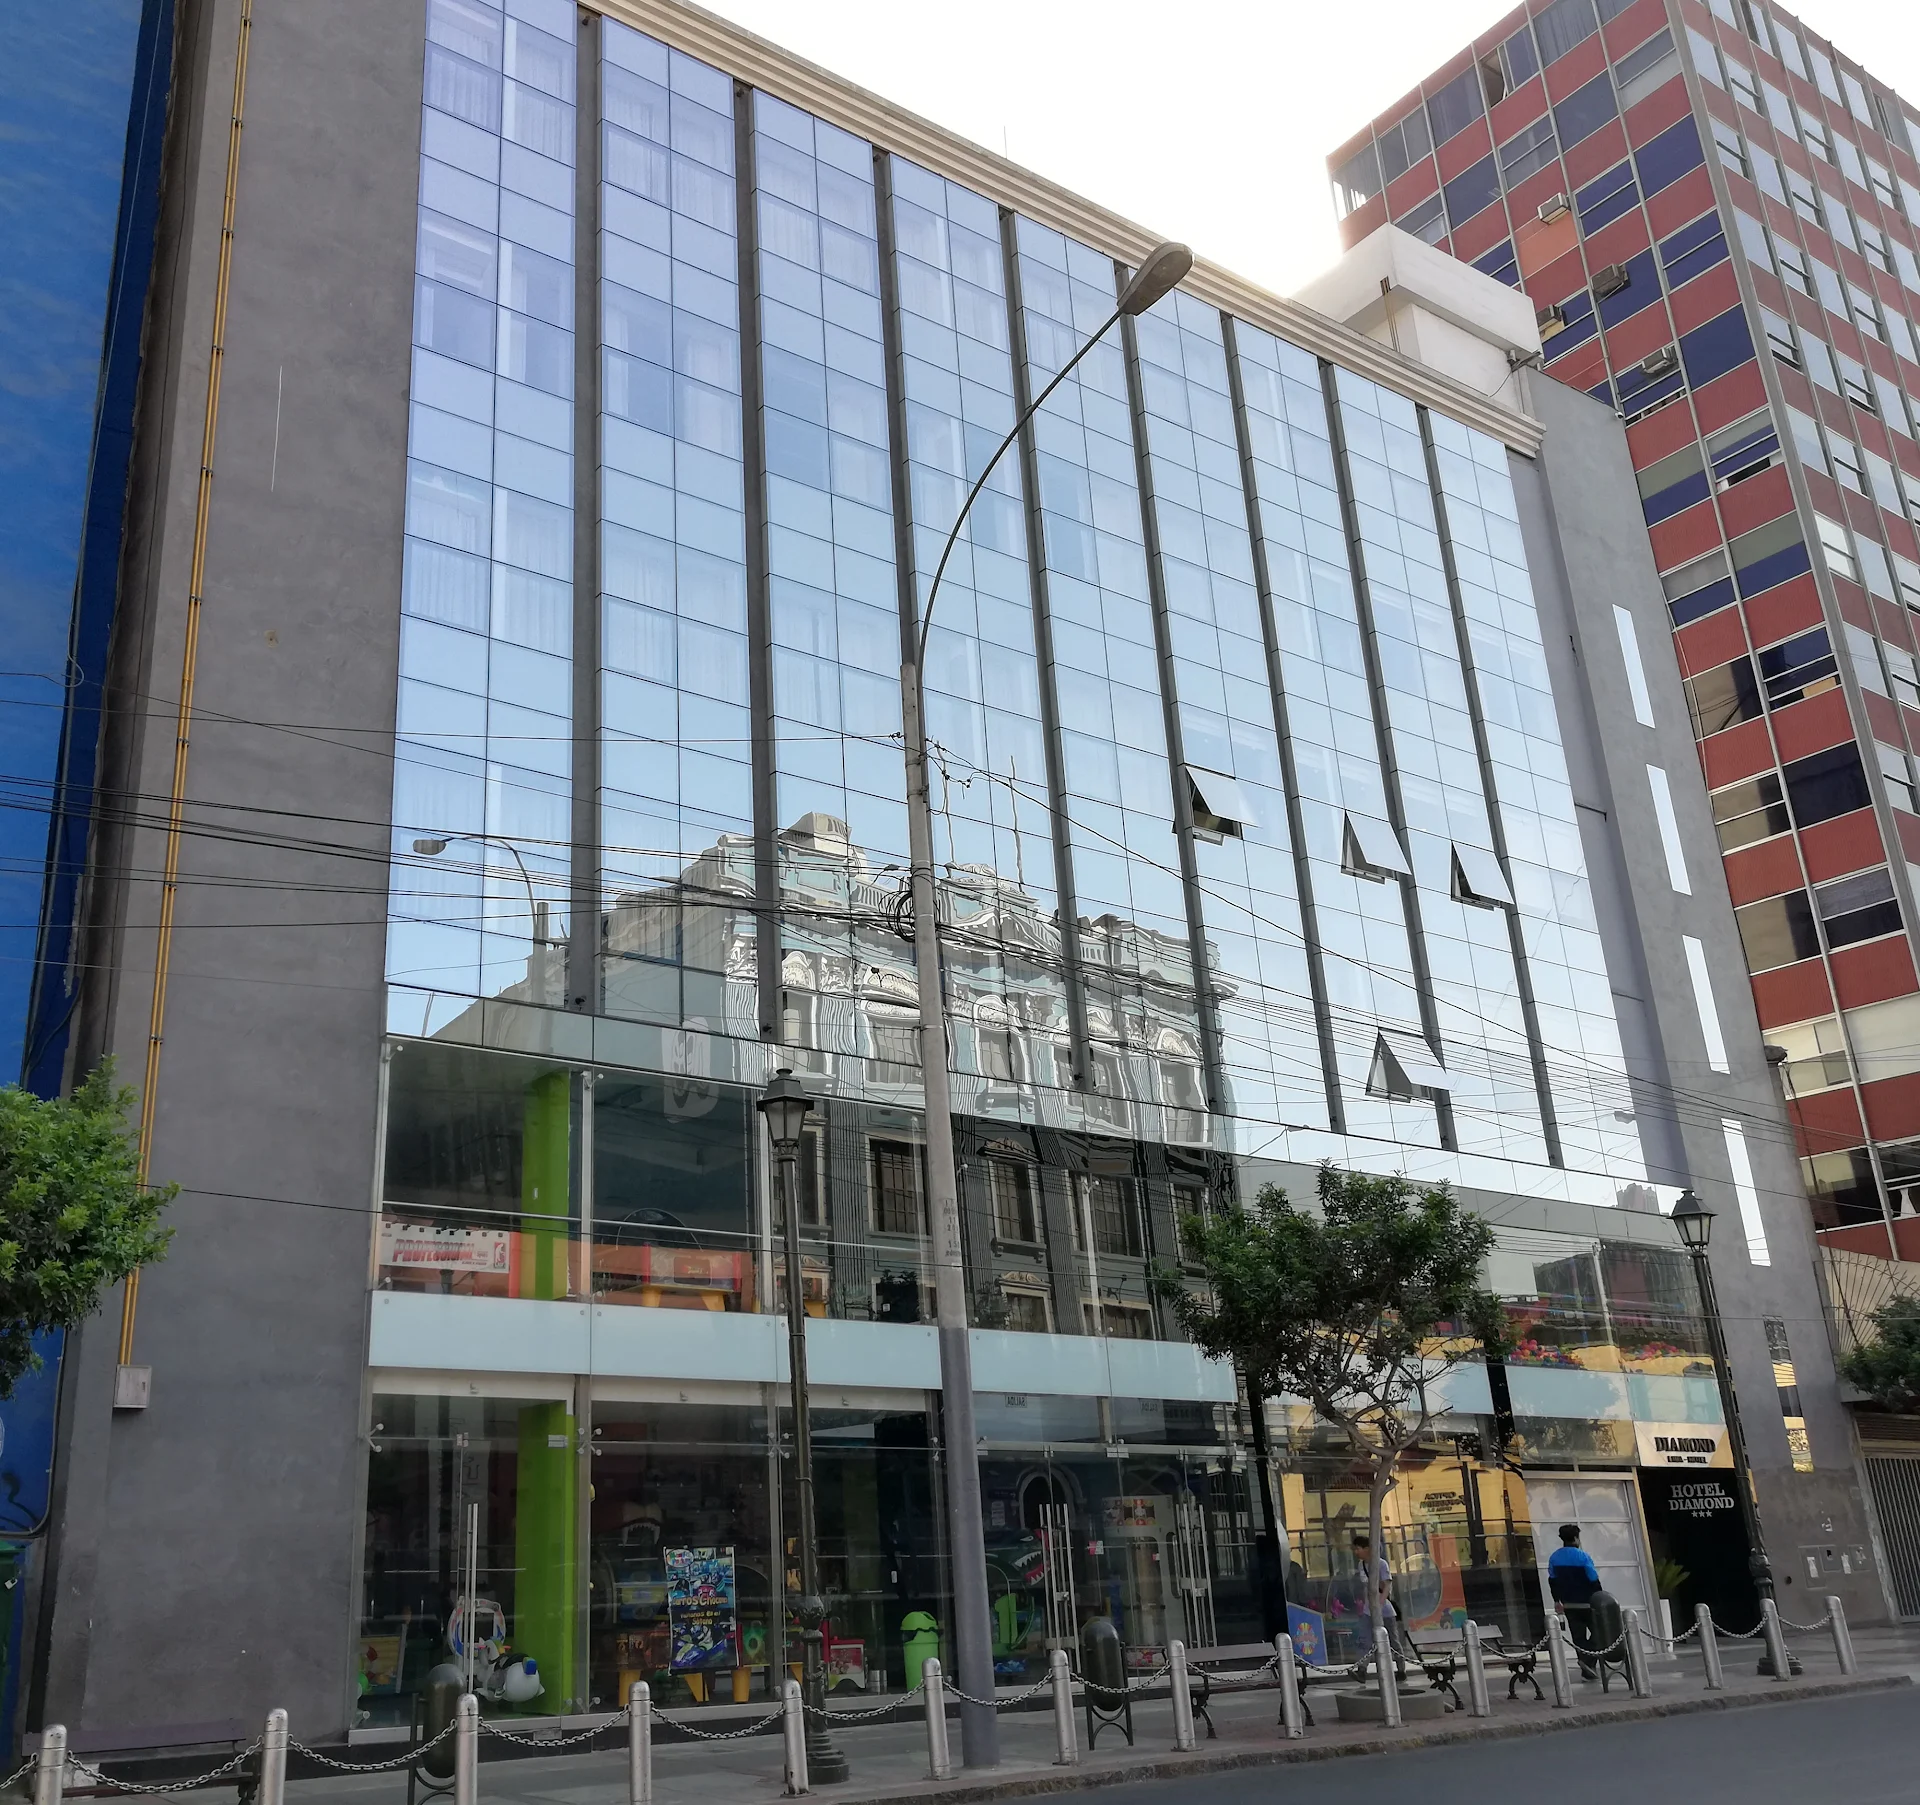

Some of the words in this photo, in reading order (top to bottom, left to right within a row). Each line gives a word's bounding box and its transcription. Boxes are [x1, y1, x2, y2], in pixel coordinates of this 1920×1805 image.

[1654, 1437, 1717, 1452] DIAMOND
[1670, 1483, 1726, 1497] HOTEL
[1668, 1497, 1735, 1511] DIAMOND
